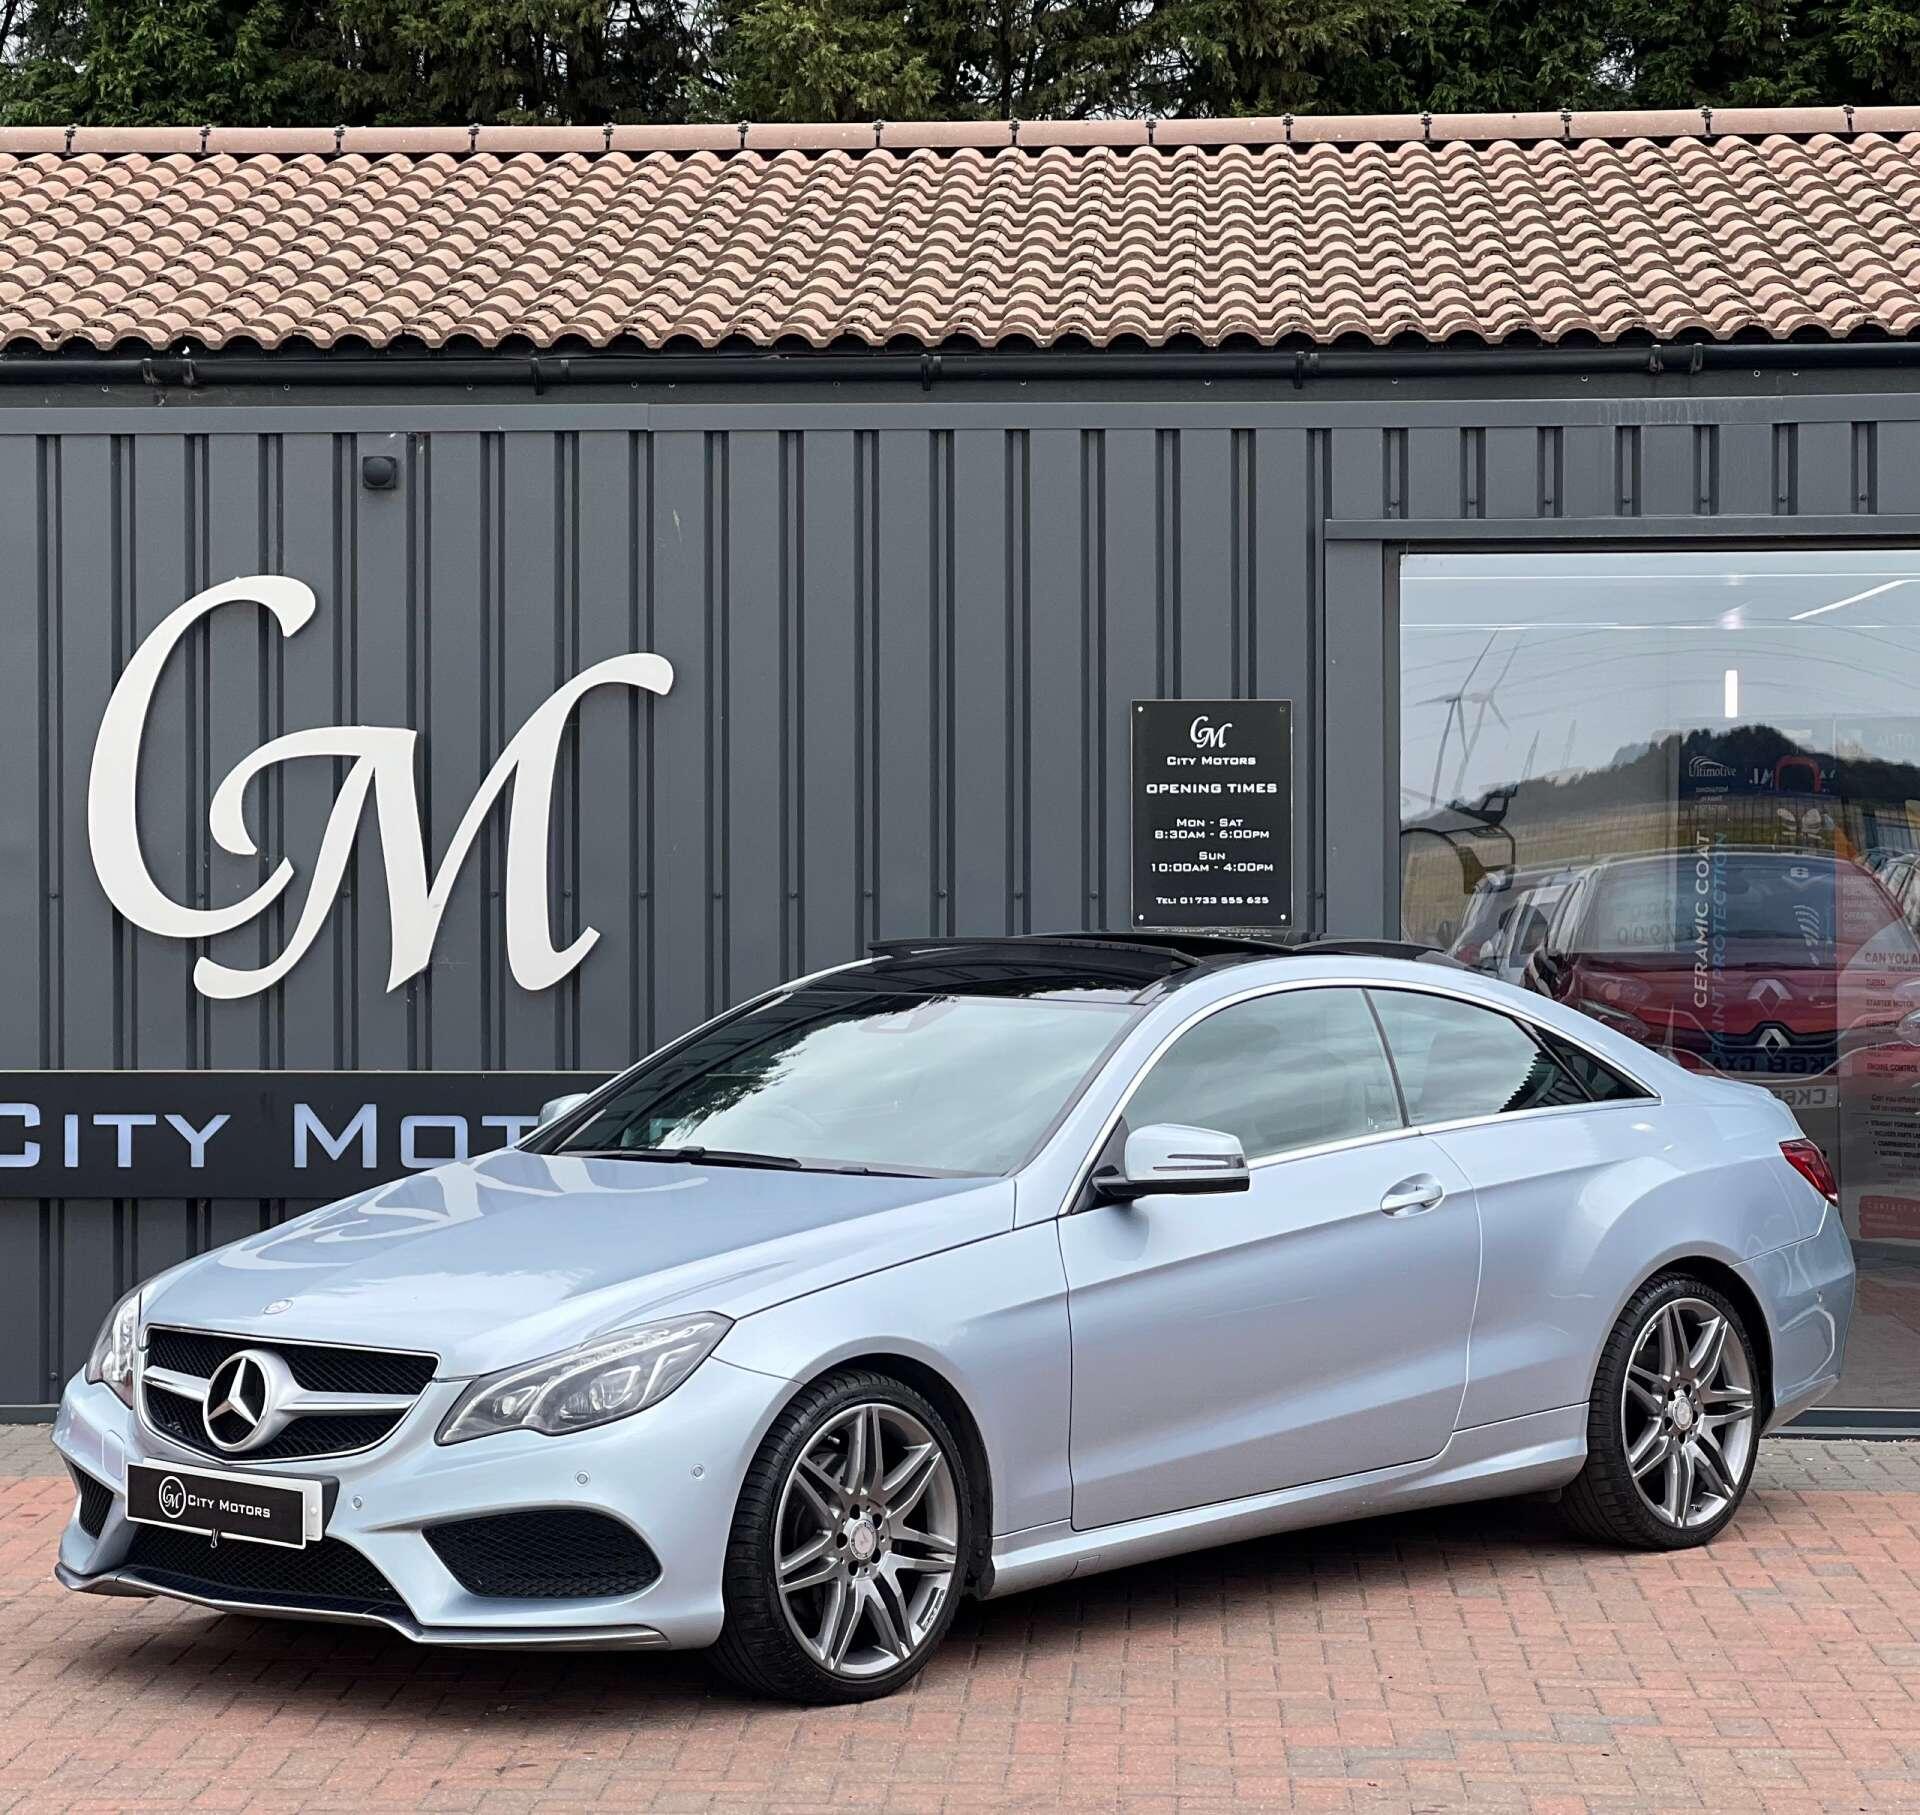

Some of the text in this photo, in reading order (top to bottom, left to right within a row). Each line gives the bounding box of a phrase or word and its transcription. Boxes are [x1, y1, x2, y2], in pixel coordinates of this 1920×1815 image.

[1166, 756, 1257, 766] CITY MOTORS
[1146, 783, 1278, 794] OPENING TIMES
[1179, 896, 1218, 905] 01733
[1220, 896, 1243, 905] 555
[1246, 896, 1270, 905] 625
[1712, 831, 1729, 982] PROTECTION
[1694, 831, 1711, 1008] CERAMIC COAT
[187, 1494, 215, 1509] CITY
[219, 1500, 271, 1518] MOTORS
